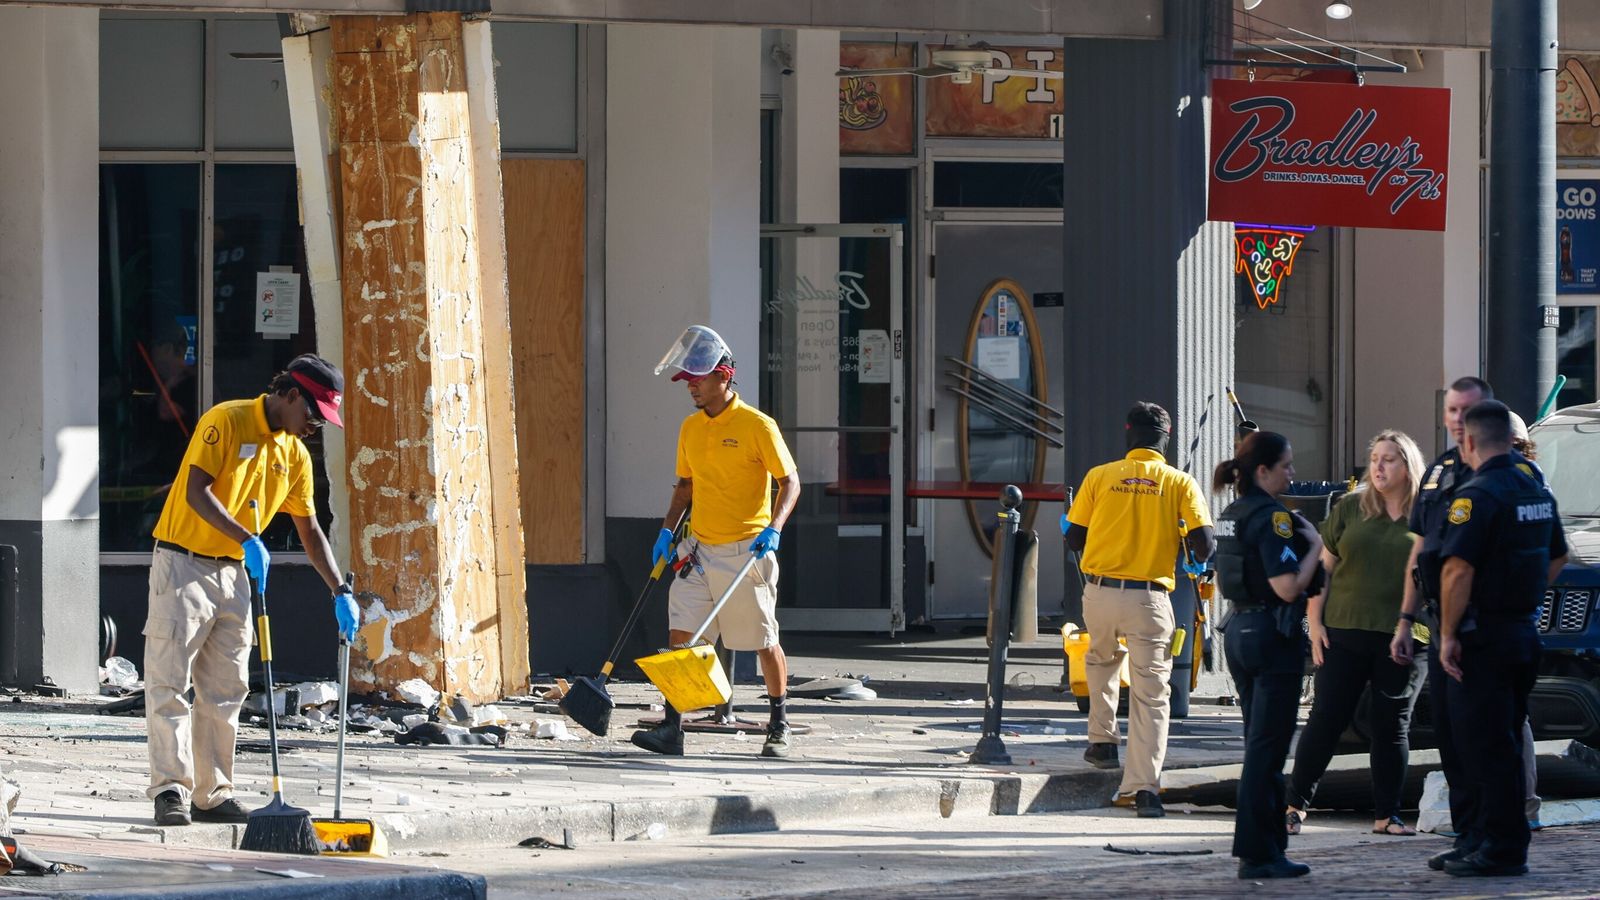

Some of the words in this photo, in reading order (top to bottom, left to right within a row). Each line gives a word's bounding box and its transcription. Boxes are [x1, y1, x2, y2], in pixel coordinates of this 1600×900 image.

[1214, 95, 1424, 196] Bradley's
[1263, 172, 1300, 182] DRINKS.
[1301, 173, 1331, 183] DIVAS.
[1332, 174, 1366, 185] DANCE.
[1389, 174, 1409, 186] on
[1391, 168, 1444, 215] 7th
[1563, 187, 1597, 207] GO
[1556, 208, 1597, 220] DOWS
[1516, 502, 1553, 521] POLICE
[1214, 520, 1236, 537] LICE
